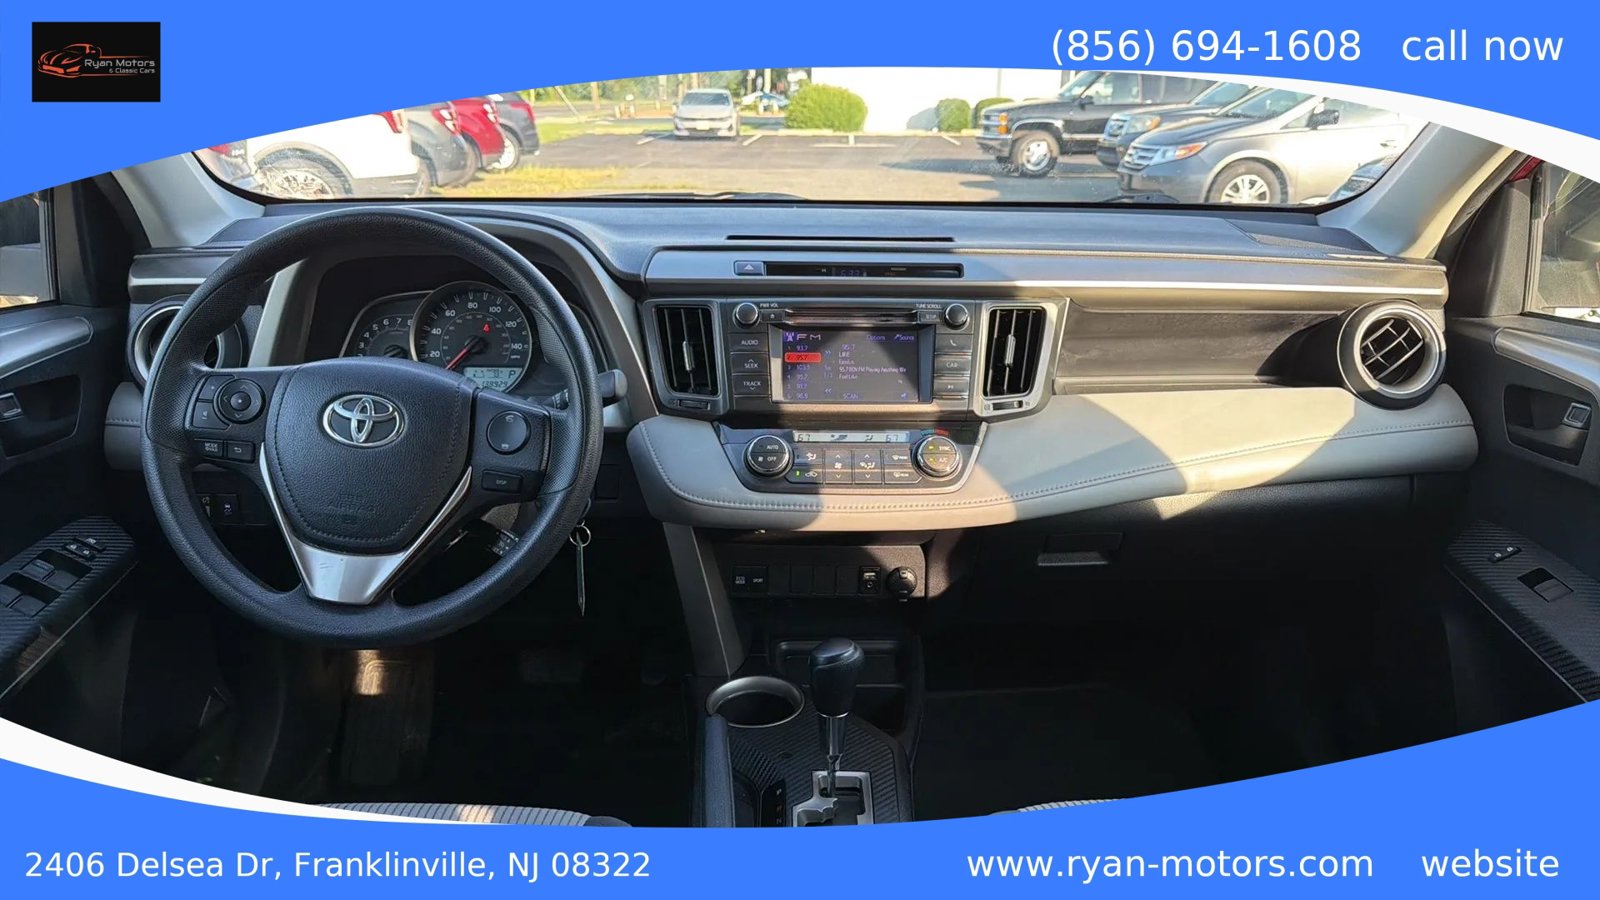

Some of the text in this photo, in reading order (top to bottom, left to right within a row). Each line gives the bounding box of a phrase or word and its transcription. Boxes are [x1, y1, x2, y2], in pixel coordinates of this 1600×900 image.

[445, 309, 456, 317] 60
[383, 318, 389, 326] 6
[505, 320, 517, 328] 120
[372, 323, 379, 331] 5
[429, 350, 440, 358] 20
[508, 369, 516, 379] P
